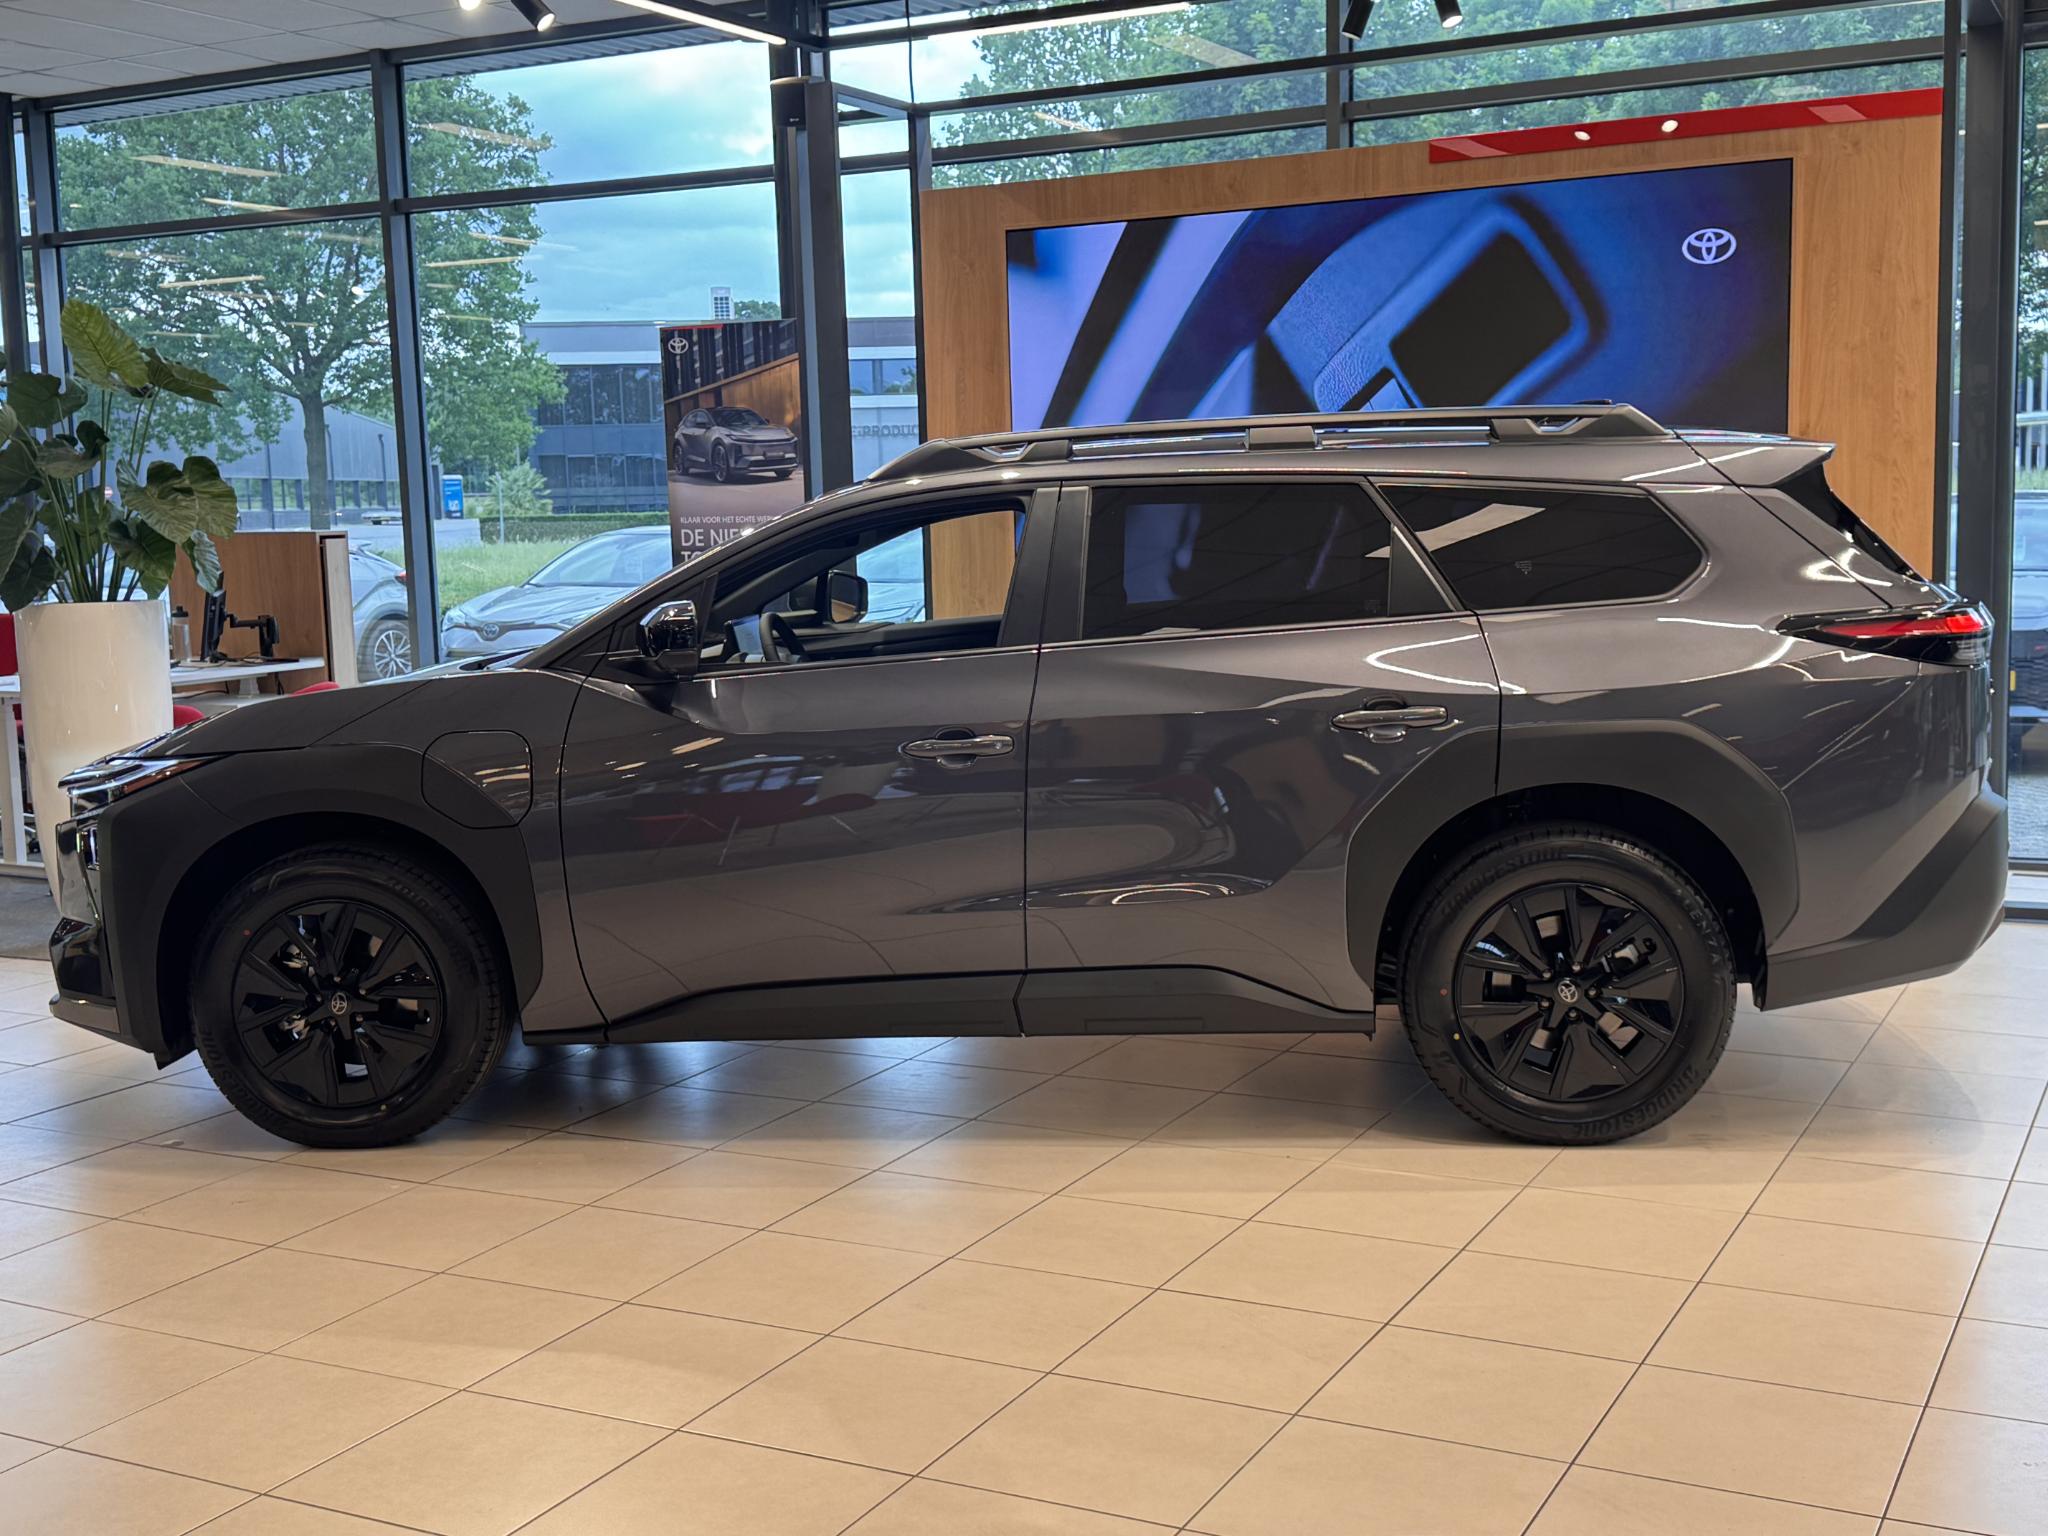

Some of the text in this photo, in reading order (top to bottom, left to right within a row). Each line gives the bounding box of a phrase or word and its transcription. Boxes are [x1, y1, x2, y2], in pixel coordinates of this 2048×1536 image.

[680, 515, 776, 524] KLAAR VOOR HET ECHTE WER
[681, 528, 743, 546] DE NIE
[1572, 1064, 1699, 1136] BRIDGESTONE
